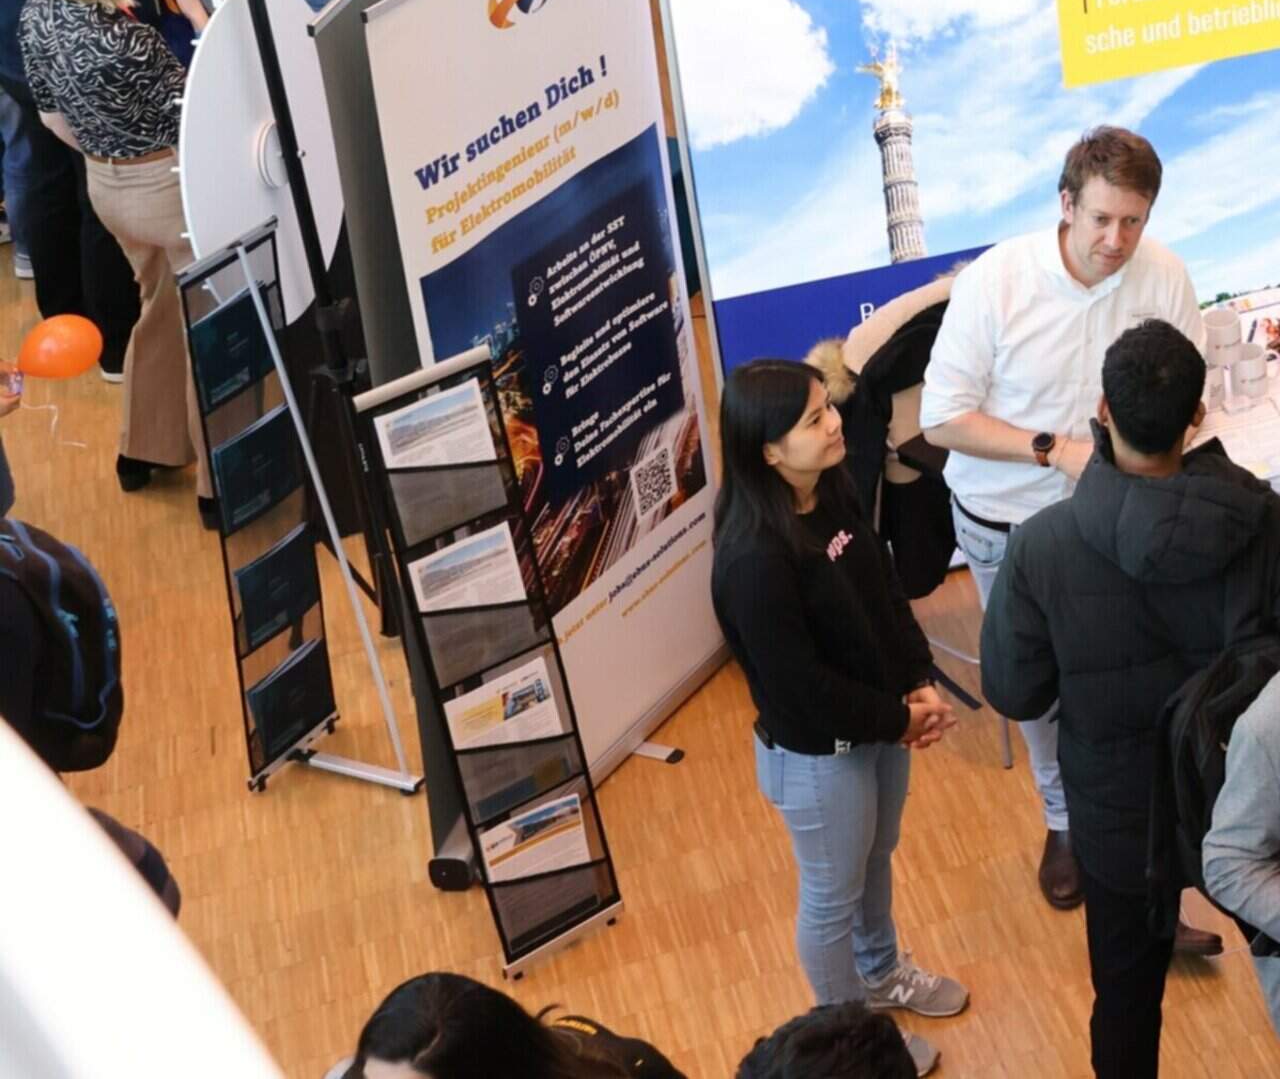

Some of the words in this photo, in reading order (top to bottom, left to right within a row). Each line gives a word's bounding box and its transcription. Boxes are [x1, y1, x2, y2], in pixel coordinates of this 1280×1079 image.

[1086, 24, 1135, 55] sche
[1142, 16, 1181, 43] und
[414, 153, 460, 191] Wir
[465, 101, 541, 162] suchen
[545, 65, 594, 110] Dich
[599, 54, 608, 77] !
[425, 135, 550, 224] Projektingenieur
[553, 88, 620, 144] (m/w/d)
[431, 229, 457, 254] für
[460, 146, 577, 236] Elektromobilität
